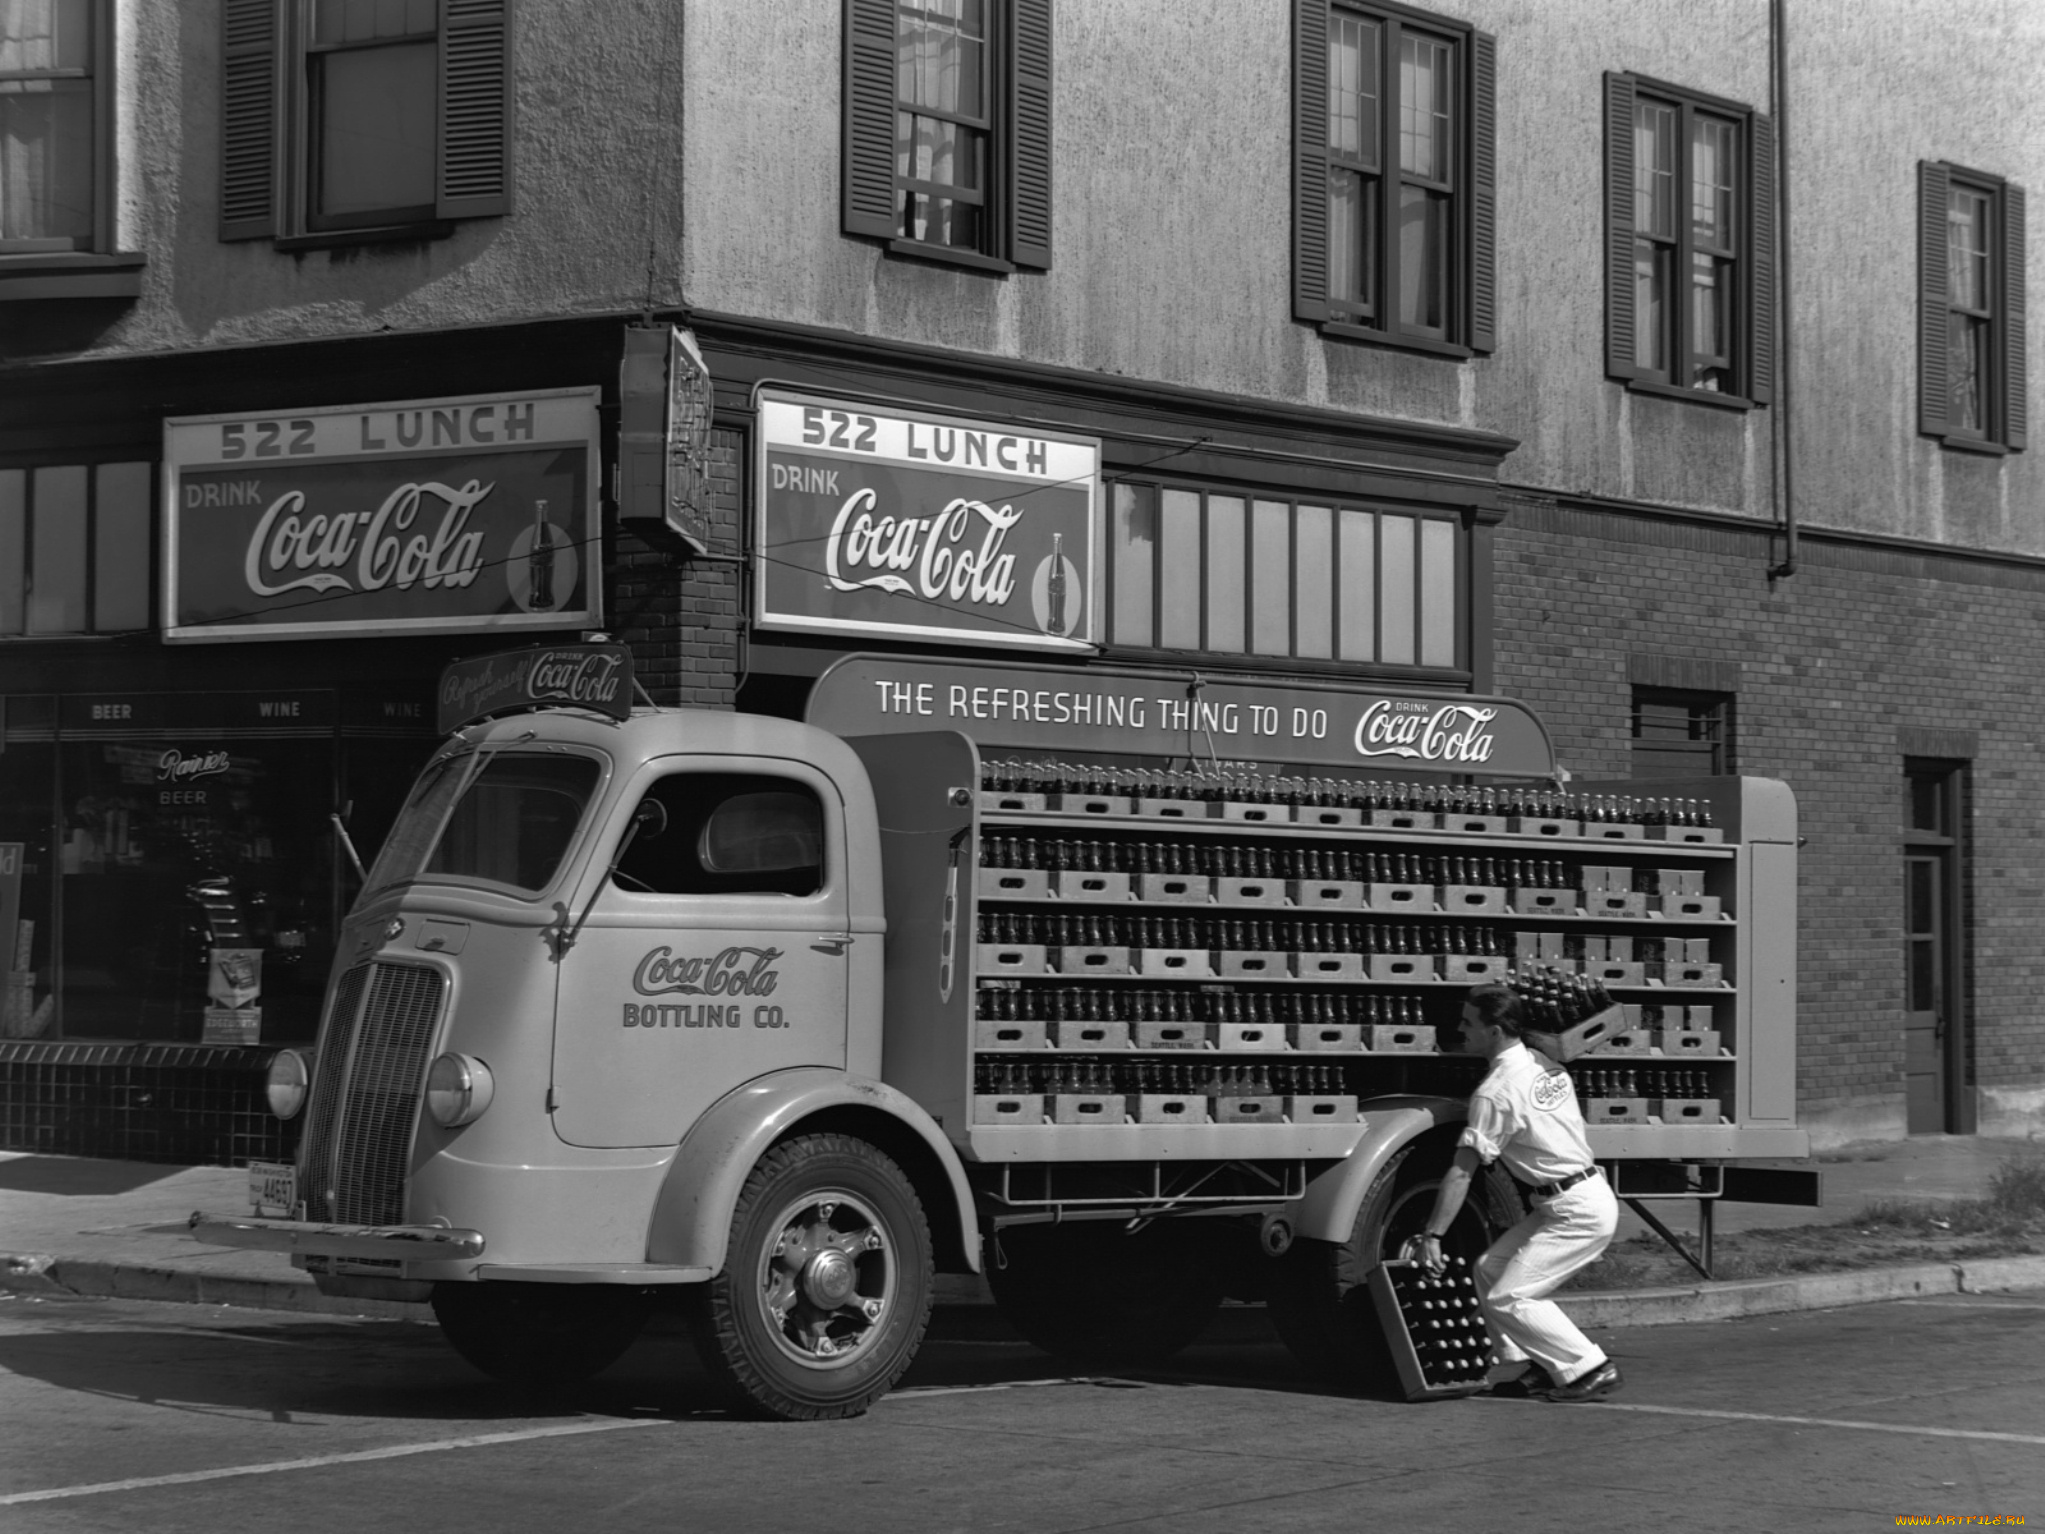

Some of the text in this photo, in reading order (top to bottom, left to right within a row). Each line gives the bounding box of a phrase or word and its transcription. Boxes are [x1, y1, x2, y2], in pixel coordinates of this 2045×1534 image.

[222, 403, 536, 459] 522 LUNCH
[803, 406, 1048, 475] 522 LUNCH
[186, 480, 262, 509] DRINK
[771, 463, 840, 496] DRINK
[245, 478, 497, 598] Coca-Cola
[826, 487, 1025, 607] Coca-Cola
[554, 652, 585, 661] DRINK
[527, 651, 624, 702] Coca-Cola
[91, 705, 133, 720] BEER
[258, 702, 301, 718] WINE
[383, 702, 422, 717] WINE
[875, 680, 1328, 740] THE REFRESHING THING TO DO
[1396, 702, 1429, 713] DRINK
[1354, 699, 1498, 763] Coca-Cola
[156, 748, 231, 783] Rainier
[159, 790, 208, 805] BEER
[632, 945, 785, 998] Coca-Cola
[623, 1003, 790, 1028] BOTTLING CO.
